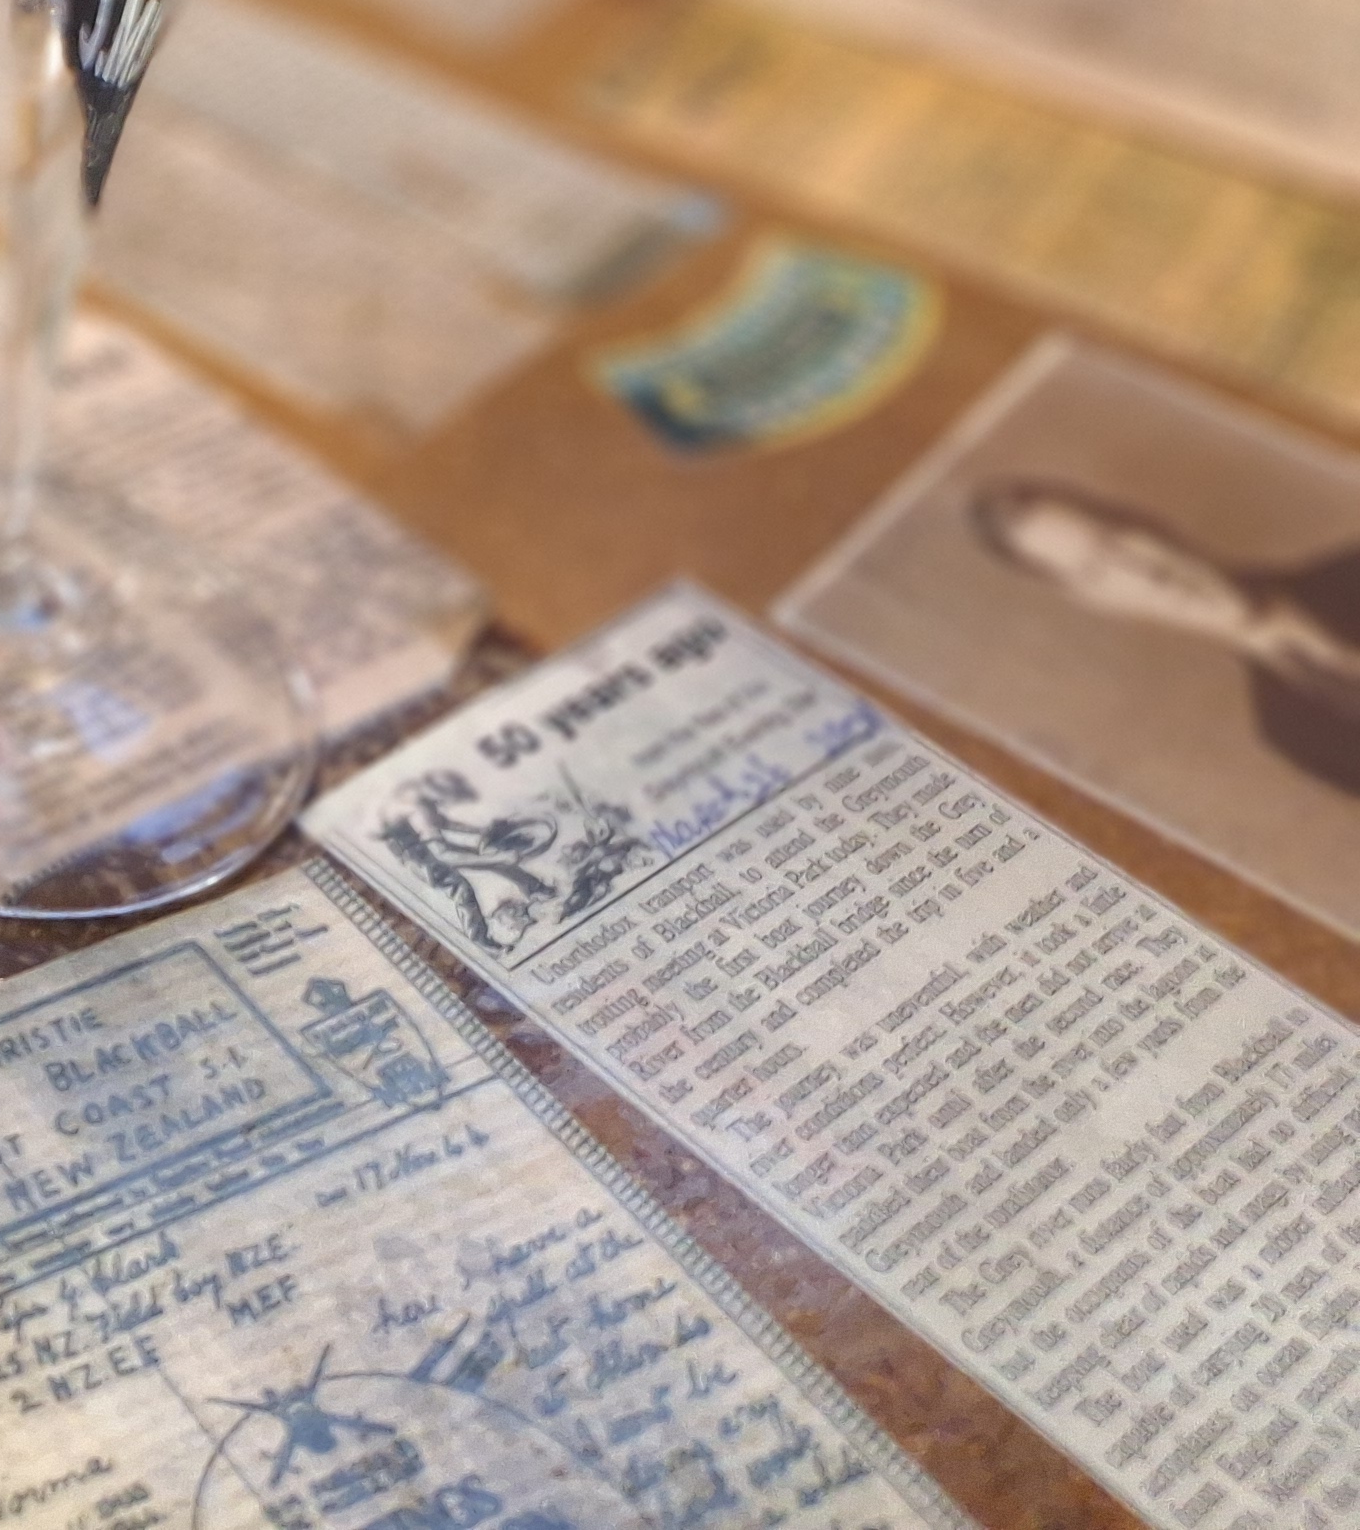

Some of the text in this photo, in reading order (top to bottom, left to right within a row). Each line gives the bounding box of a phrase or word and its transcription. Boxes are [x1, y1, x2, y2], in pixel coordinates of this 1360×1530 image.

[477, 722, 540, 769] 50
[541, 661, 653, 741] years
[550, 959, 629, 1015] residents
[630, 934, 655, 960] of
[738, 866, 763, 884] to
[813, 812, 845, 833] the
[637, 862, 714, 914] transport
[715, 838, 752, 862] was
[45, 1002, 237, 1092] BLACKBALL
[4, 1077, 267, 1212] NEW ZEALAND
[54, 1073, 172, 1136] COAST
